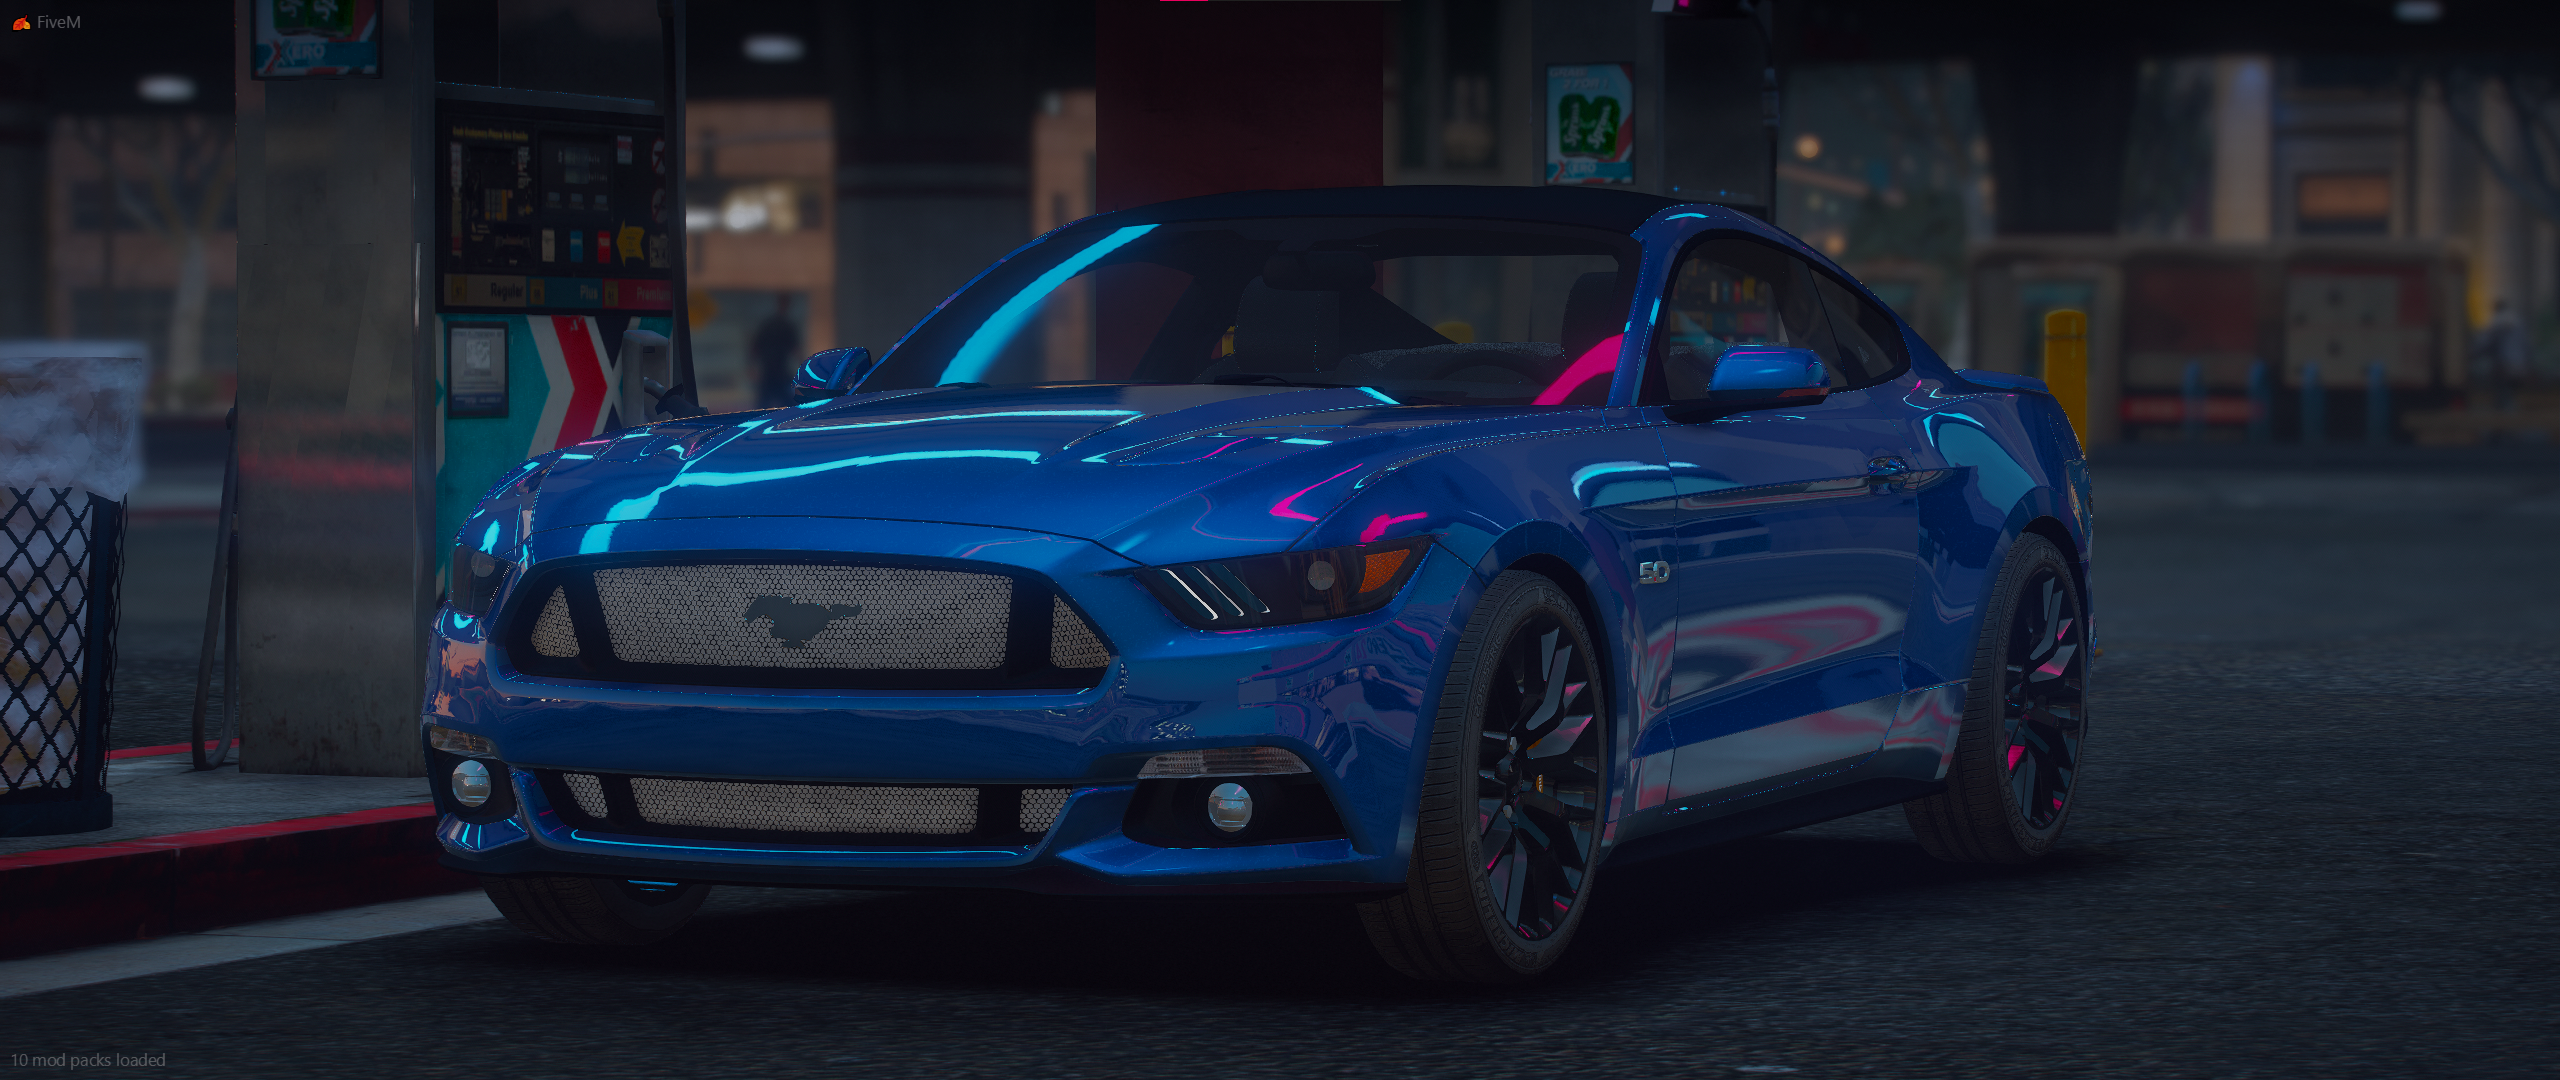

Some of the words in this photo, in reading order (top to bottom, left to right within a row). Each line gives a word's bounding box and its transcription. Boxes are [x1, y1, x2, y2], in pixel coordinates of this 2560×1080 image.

[491, 282, 524, 302] Regular
[580, 284, 599, 300] Plus
[636, 286, 672, 302] Premium
[1475, 880, 1524, 964] MICHELIN
